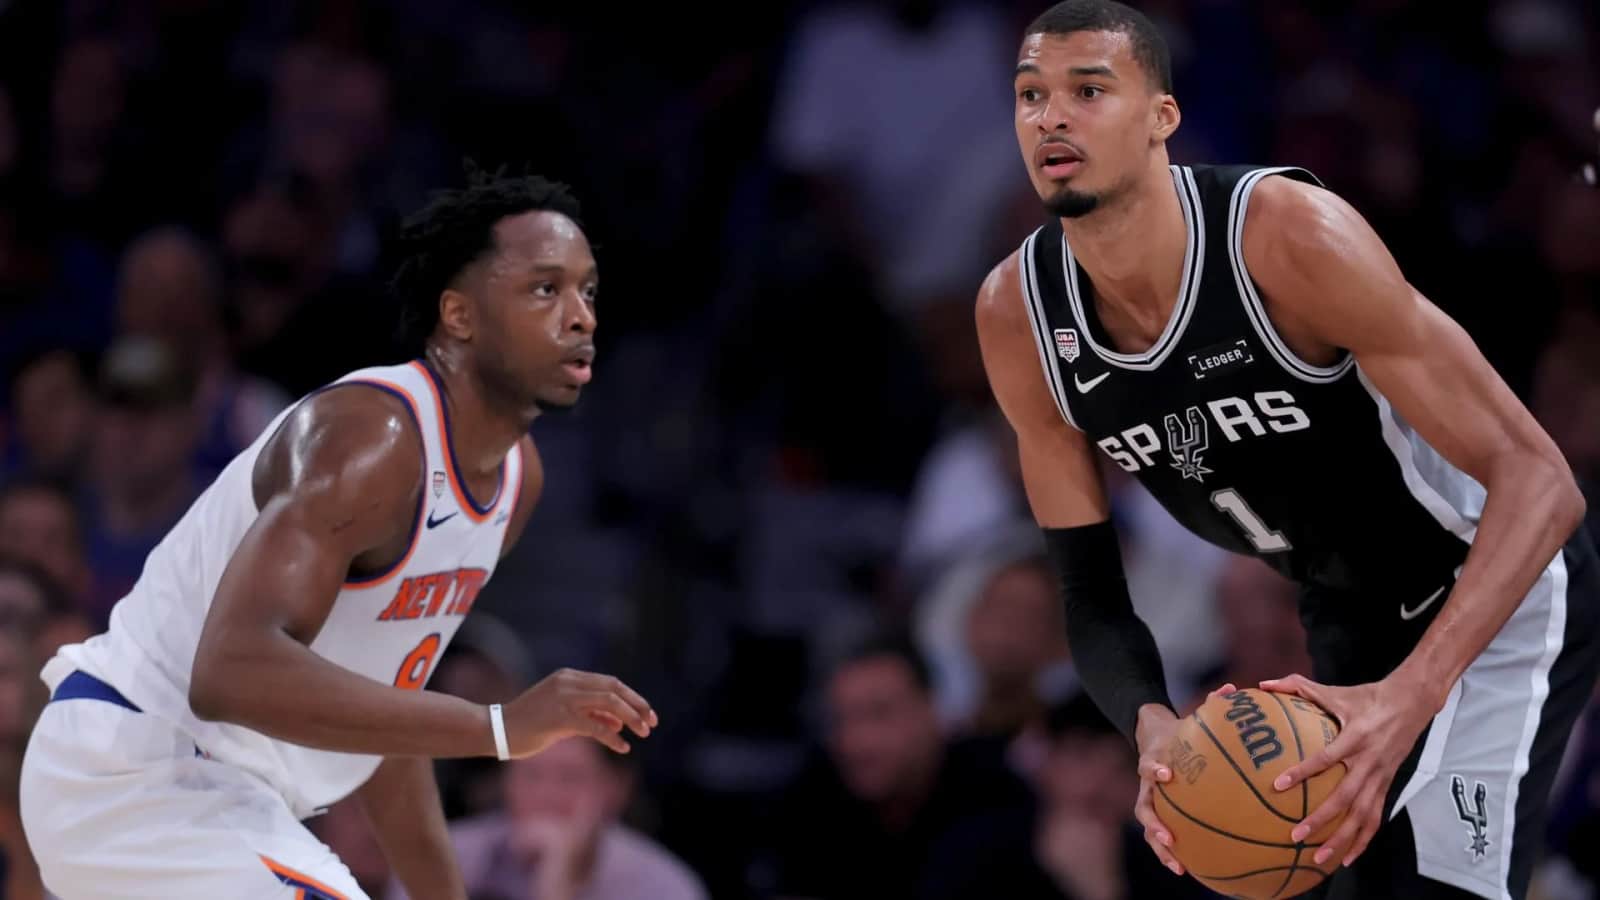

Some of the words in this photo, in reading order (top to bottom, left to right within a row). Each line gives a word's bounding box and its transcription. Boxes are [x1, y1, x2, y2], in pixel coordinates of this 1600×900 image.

[1199, 349, 1244, 371] LEDGER
[1210, 488, 1293, 553] 1
[376, 572, 456, 621] NEW
